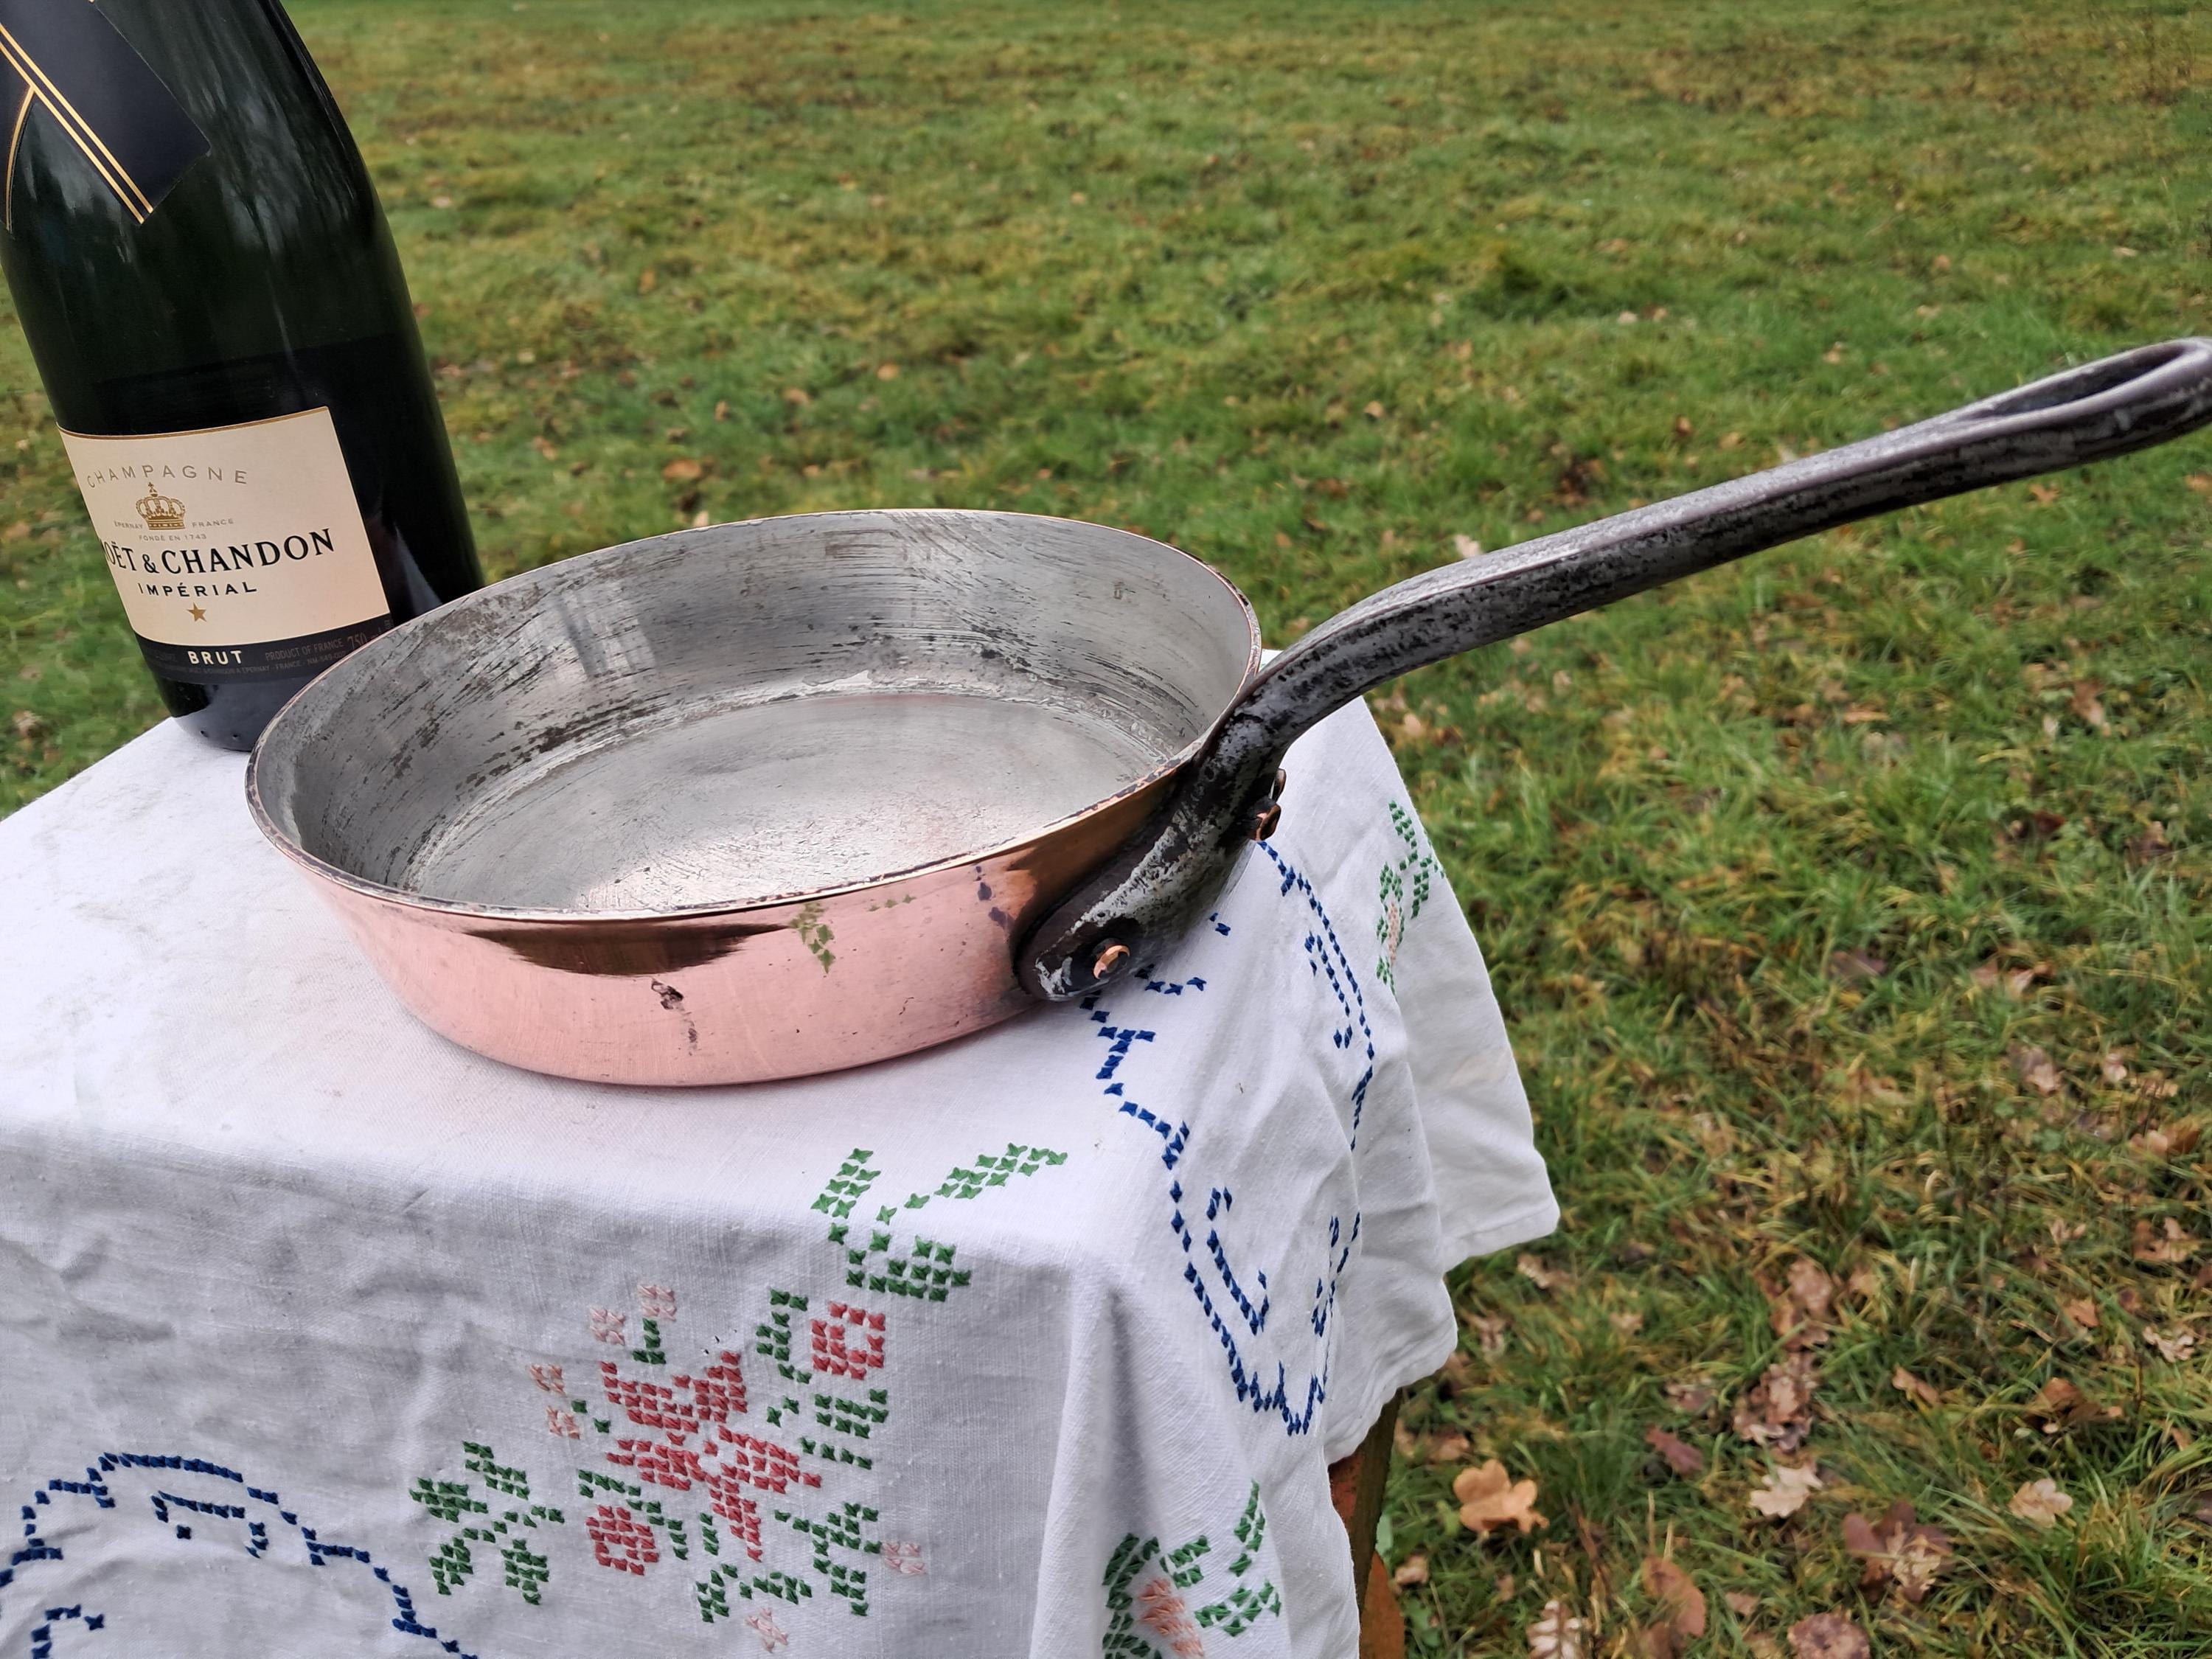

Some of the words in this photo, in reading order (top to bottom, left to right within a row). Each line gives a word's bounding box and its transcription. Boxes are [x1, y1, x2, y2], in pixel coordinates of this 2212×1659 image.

[86, 465, 248, 489] CHAMPAGNE
[192, 518, 234, 528] FRANCE
[100, 539, 137, 571] OËT
[142, 554, 160, 574] &
[161, 528, 334, 574] CHANDON
[137, 581, 257, 597] IMPÉRIAL
[187, 650, 242, 664] BRUT
[265, 647, 300, 661] PRODUCT
[302, 645, 313, 655] OF
[313, 638, 344, 653] FRANCE
